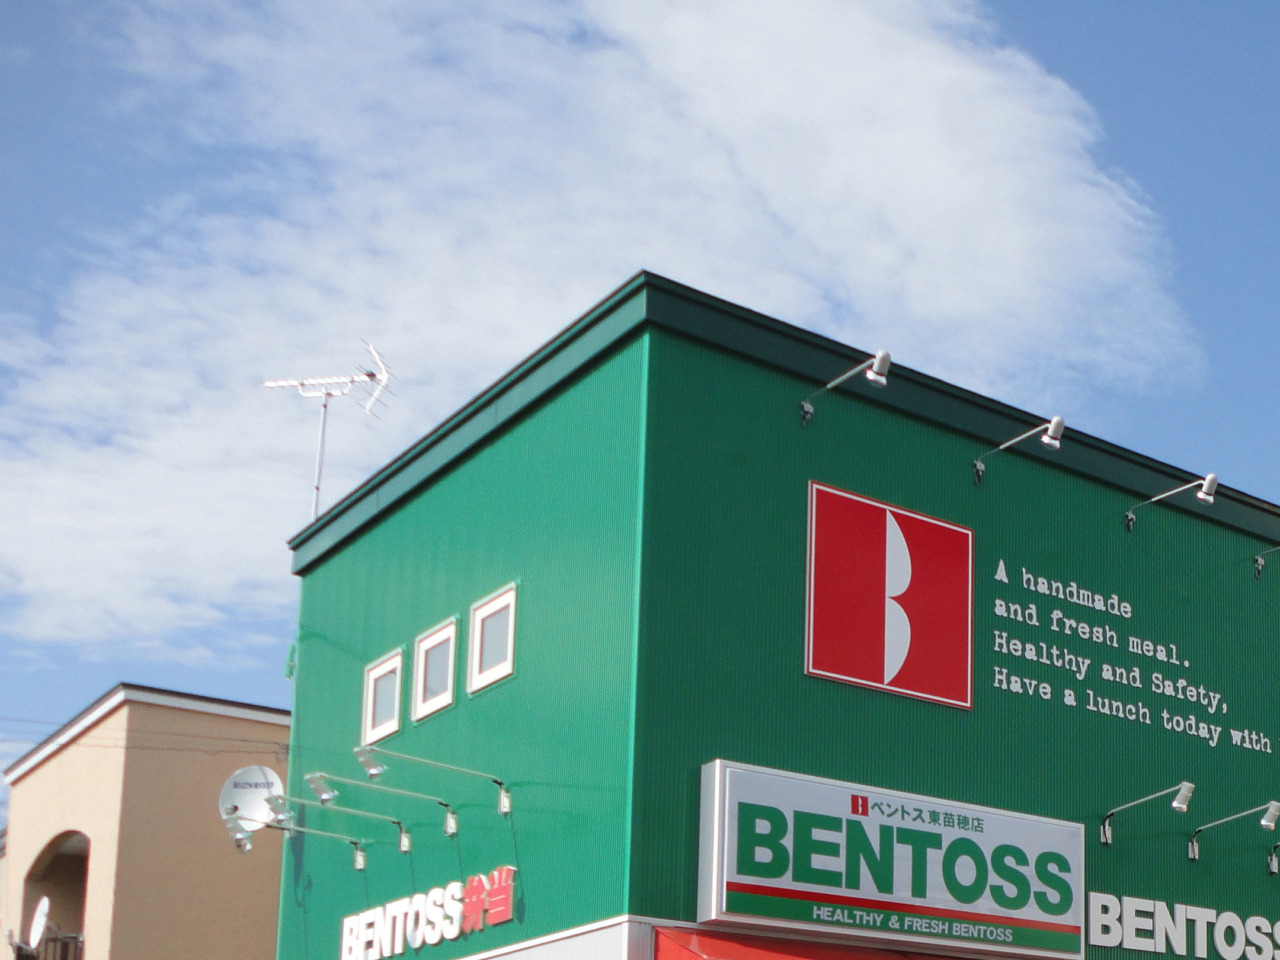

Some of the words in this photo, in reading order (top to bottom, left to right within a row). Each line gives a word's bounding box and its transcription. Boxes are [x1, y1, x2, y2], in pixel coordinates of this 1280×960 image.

[994, 558, 1009, 583] A
[1022, 566, 1132, 619] handmade
[994, 598, 1039, 626] and
[1051, 609, 1119, 648] fresh
[1129, 636, 1190, 667] meal.
[993, 630, 1091, 680] Healthy
[1102, 663, 1143, 688] and
[1152, 672, 1227, 714] Safety,
[993, 666, 1051, 700] Have
[1063, 688, 1076, 707] a
[1086, 689, 1151, 724] lunch
[1161, 709, 1222, 747] today
[1230, 729, 1272, 753] with
[736, 801, 1074, 916] BENTOSS
[812, 905, 884, 927] HEALTHY
[888, 915, 900, 929] &
[904, 917, 949, 935] FRESH
[953, 923, 1013, 942] BENTOSS
